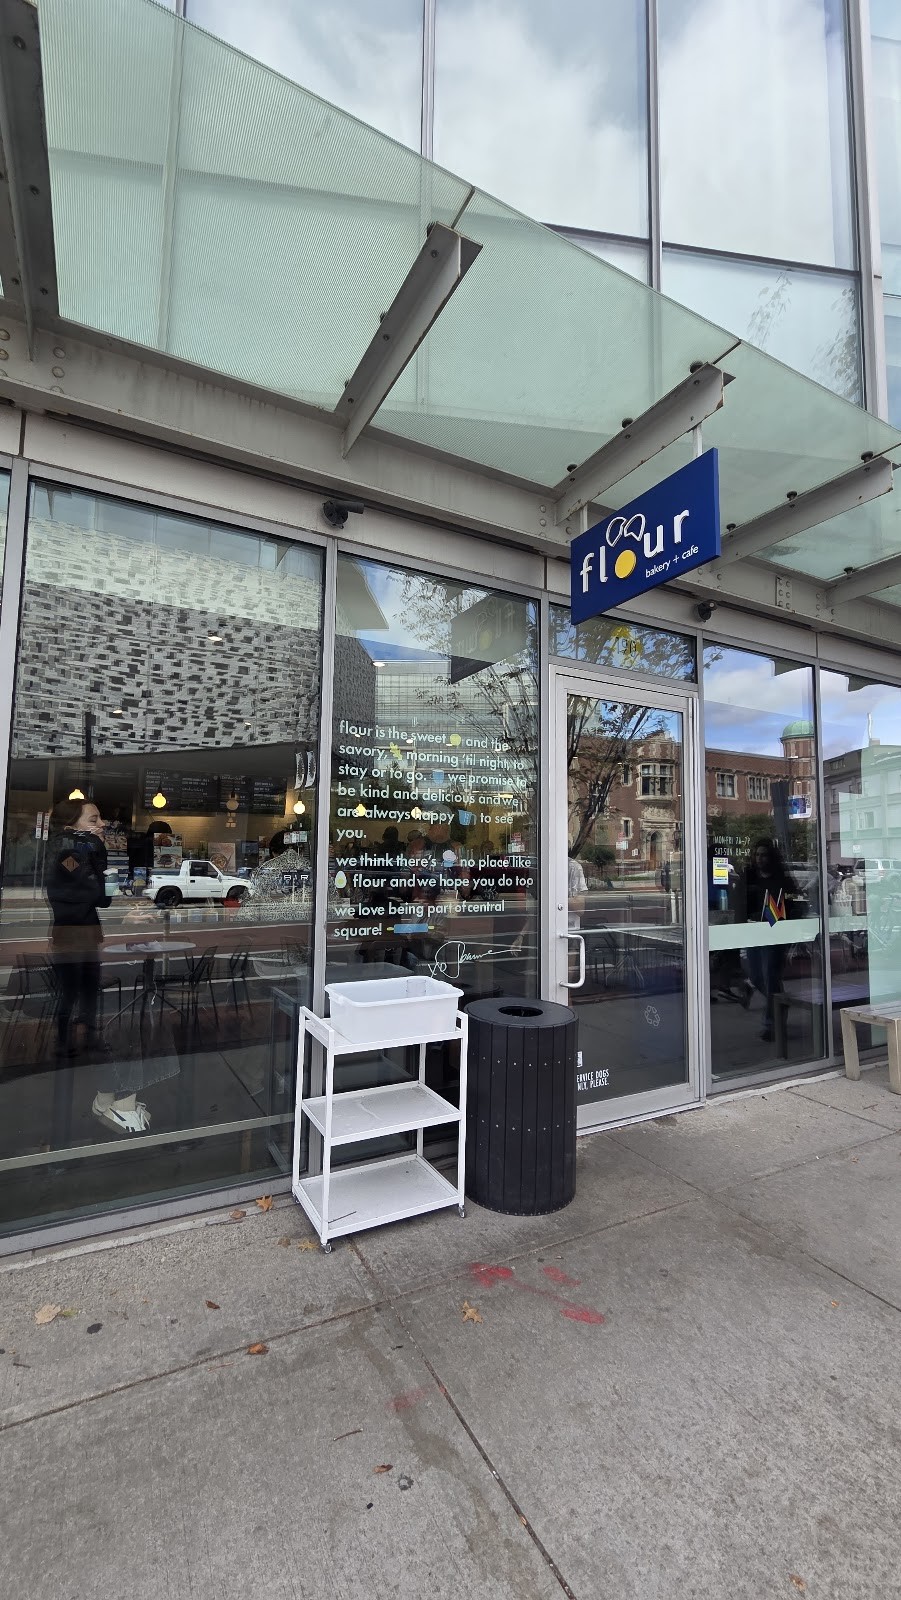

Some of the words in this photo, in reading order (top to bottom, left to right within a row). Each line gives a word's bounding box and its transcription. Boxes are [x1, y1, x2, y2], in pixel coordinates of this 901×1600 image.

[579, 509, 690, 593] flour
[645, 559, 671, 578] bakery
[673, 554, 680, 564] +
[681, 544, 699, 560] cafe
[339, 719, 373, 737] flour
[375, 724, 386, 738] is
[388, 726, 408, 740] the
[411, 732, 446, 744] sweet
[465, 737, 488, 749] and
[491, 737, 509, 751] the
[339, 744, 388, 761] savory,
[406, 750, 459, 767] morning
[513, 760, 525, 770] to
[338, 764, 367, 780] stay
[371, 768, 387, 778] or
[390, 769, 403, 779] to
[406, 771, 427, 784] go.
[448, 773, 466, 783] we
[468, 774, 513, 786] promise
[516, 776, 527, 787] to
[338, 782, 356, 796] be
[360, 783, 389, 799] kind
[393, 787, 418, 800] and
[422, 787, 476, 803] delicious
[478, 793, 500, 805] and
[502, 796, 519, 807] we
[337, 807, 361, 818] are
[364, 804, 411, 823] always
[412, 806, 455, 825] happy
[480, 812, 492, 823] to
[494, 816, 514, 824] see
[336, 829, 367, 841] you.
[336, 857, 357, 867] we
[360, 852, 394, 867] think
[396, 853, 437, 867] there's
[460, 858, 476, 867] no
[478, 855, 510, 871] place
[512, 856, 532, 868] like
[352, 873, 387, 887] flour
[389, 873, 416, 887] and
[417, 877, 437, 887] we
[439, 873, 470, 890] hope
[473, 878, 495, 890] you
[497, 873, 513, 886] do
[515, 875, 534, 886] too
[335, 906, 356, 917] we
[359, 902, 385, 916] love
[388, 901, 424, 917] being
[428, 902, 452, 917] part
[454, 900, 468, 913] of
[467, 900, 505, 912] central
[334, 922, 382, 940] square!
[576, 1072, 594, 1083] ERVICE
[595, 1069, 610, 1079] DOGS
[577, 1081, 588, 1091] NLY,
[590, 1078, 609, 1088] PLEASE.
